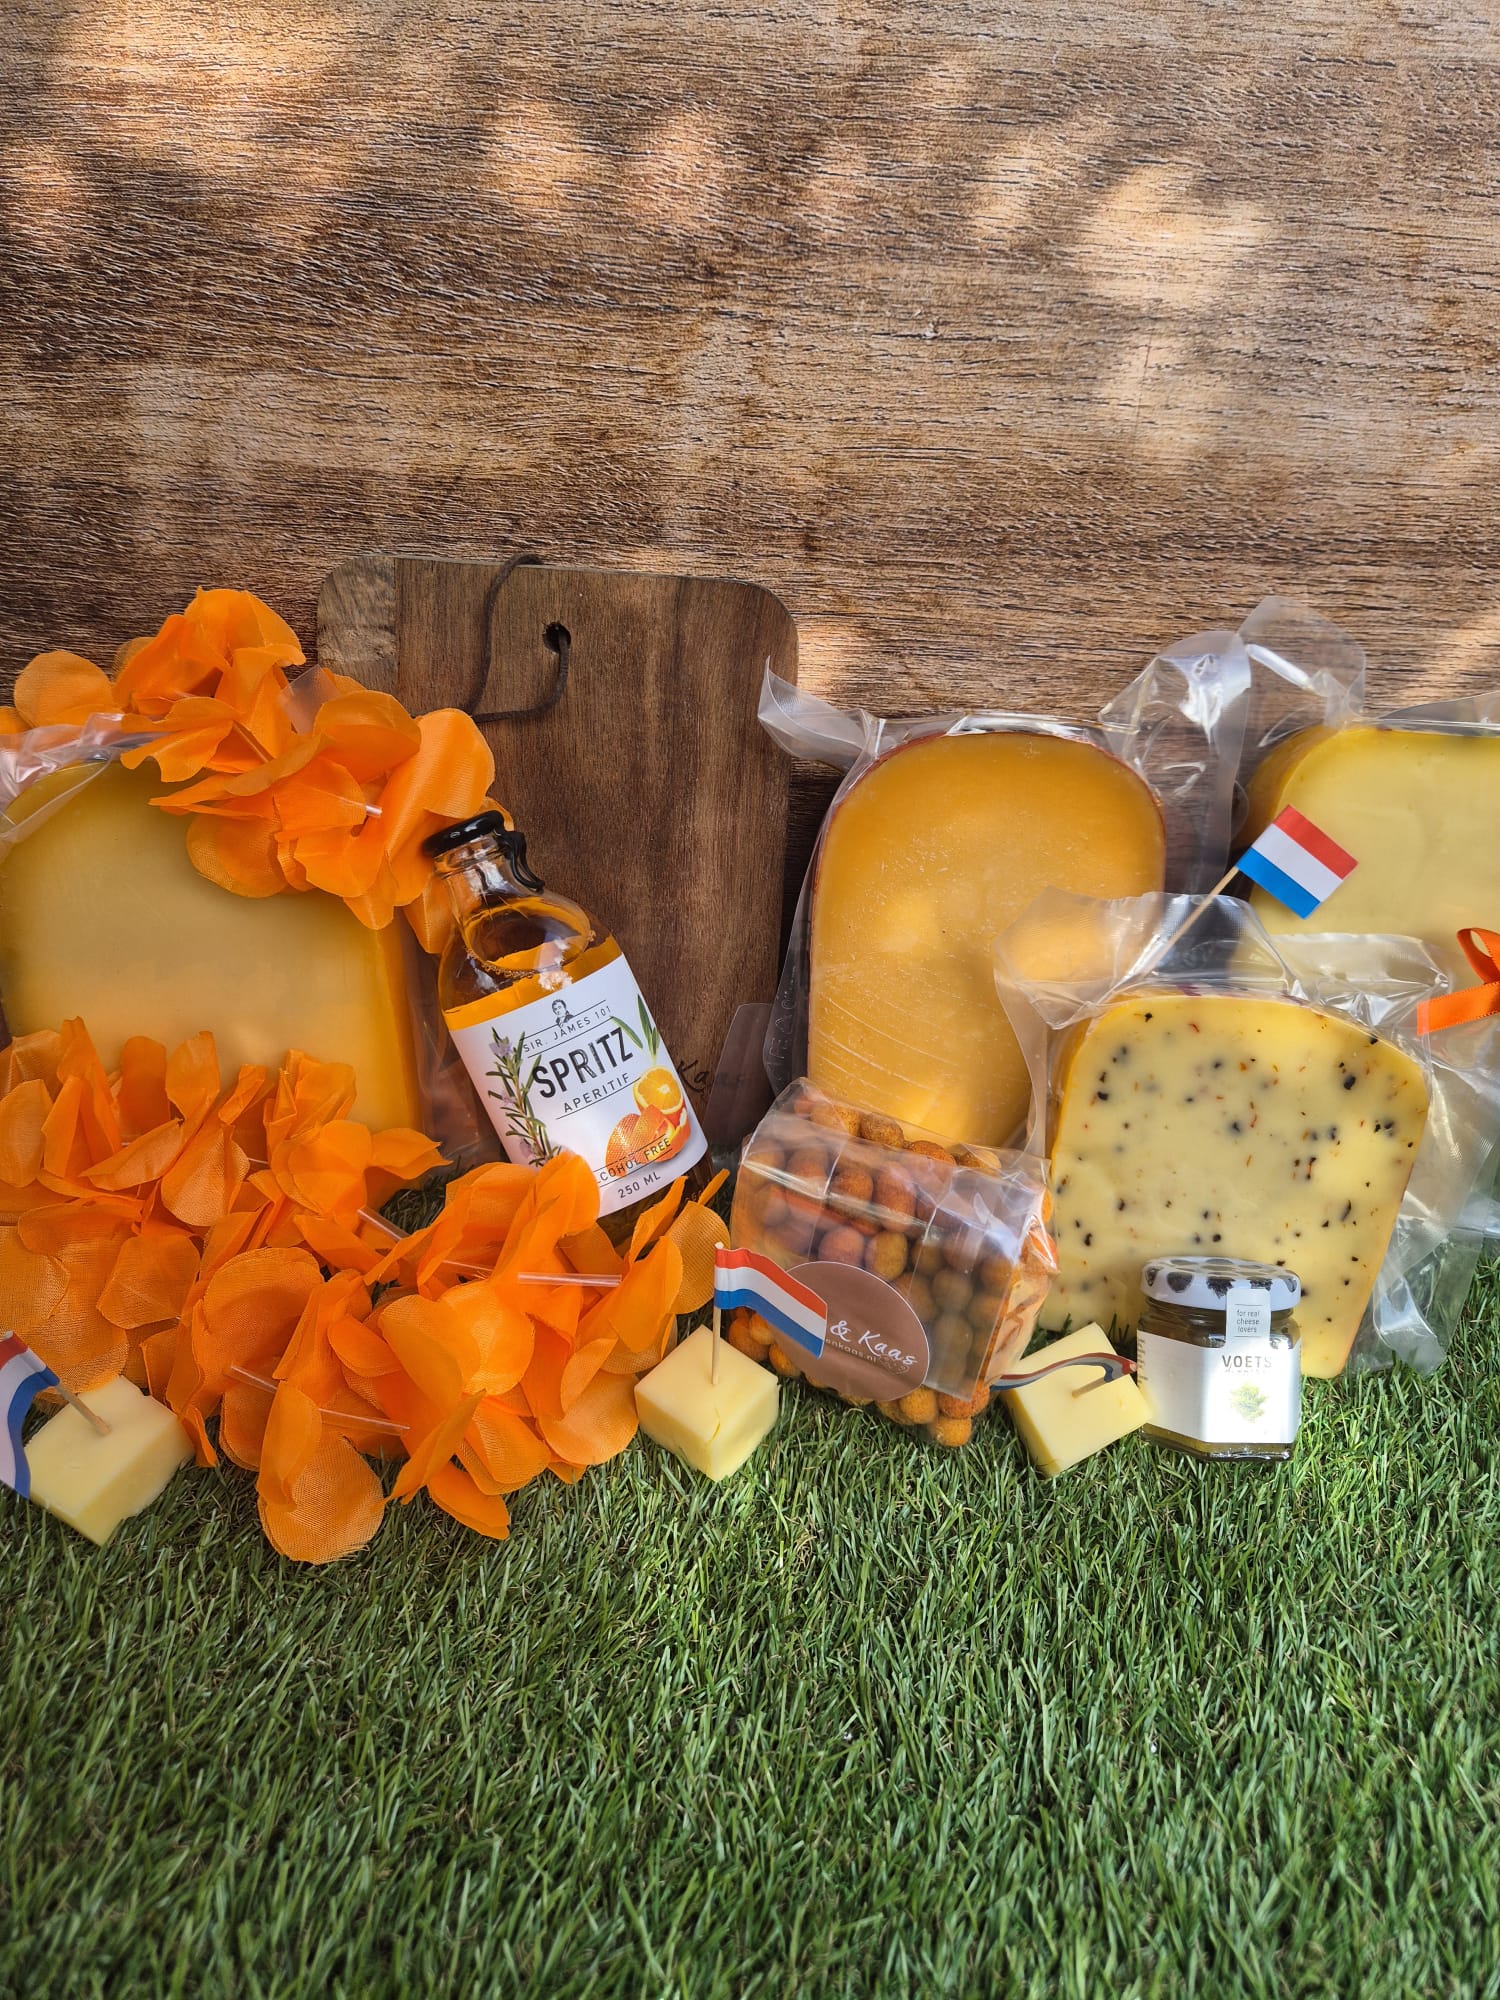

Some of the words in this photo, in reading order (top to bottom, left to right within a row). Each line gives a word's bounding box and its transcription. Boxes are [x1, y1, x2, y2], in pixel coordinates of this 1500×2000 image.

[522, 1038, 548, 1053] SIR.
[553, 1018, 591, 1040] JAMES
[595, 1005, 612, 1019] 101
[532, 1027, 633, 1098] SPRITZ
[563, 1072, 630, 1113] APERITIF
[597, 1157, 643, 1183] COHOL
[643, 1137, 671, 1160] FREE
[617, 1181, 640, 1199] 250
[643, 1171, 661, 1186] ML
[1236, 1309, 1247, 1317] for
[1247, 1309, 1260, 1317] real
[1236, 1317, 1261, 1325] cheese
[825, 1338, 877, 1363] enkaas.nl
[829, 1320, 852, 1343] &
[858, 1330, 918, 1365] Kaas
[1222, 1354, 1272, 1369] VOETS
